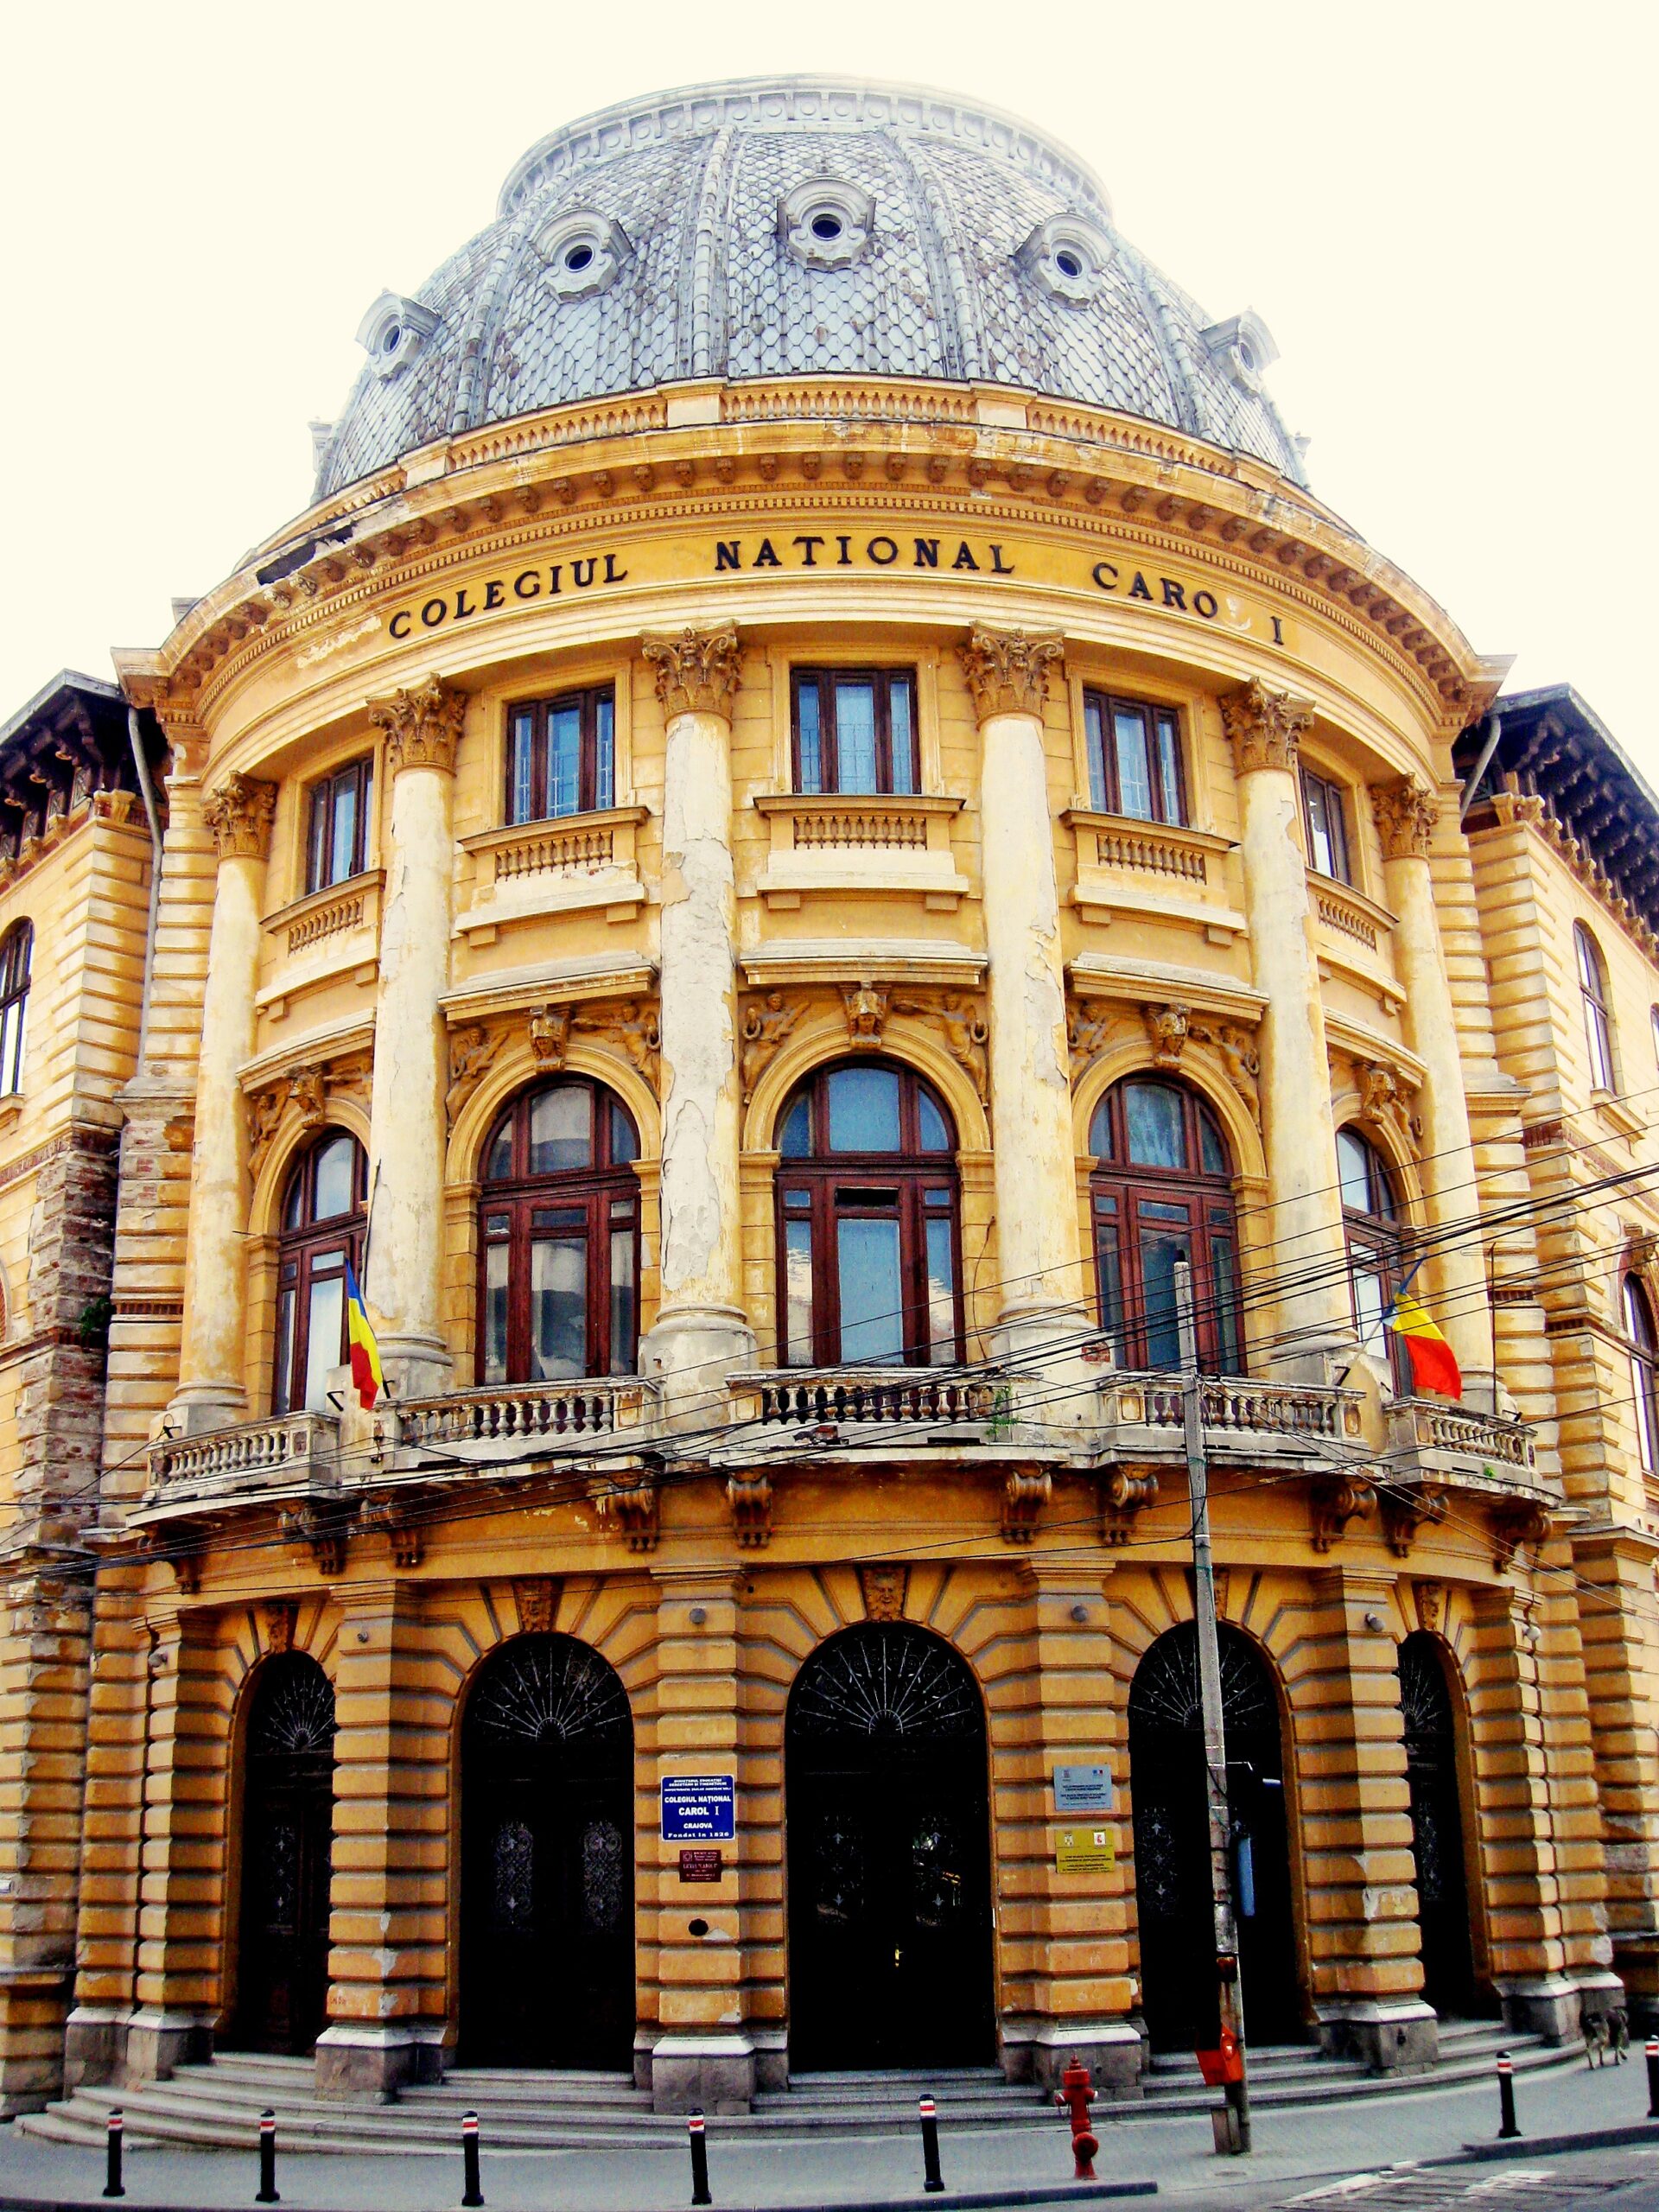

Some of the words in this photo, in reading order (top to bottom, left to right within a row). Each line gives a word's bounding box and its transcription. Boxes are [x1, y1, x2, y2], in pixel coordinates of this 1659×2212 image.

[389, 554, 628, 639] COLEGIUL
[715, 536, 1015, 574] NATIONAL
[1269, 615, 1285, 646] I
[678, 1807, 709, 1816] CAROL
[715, 1805, 719, 1815] I
